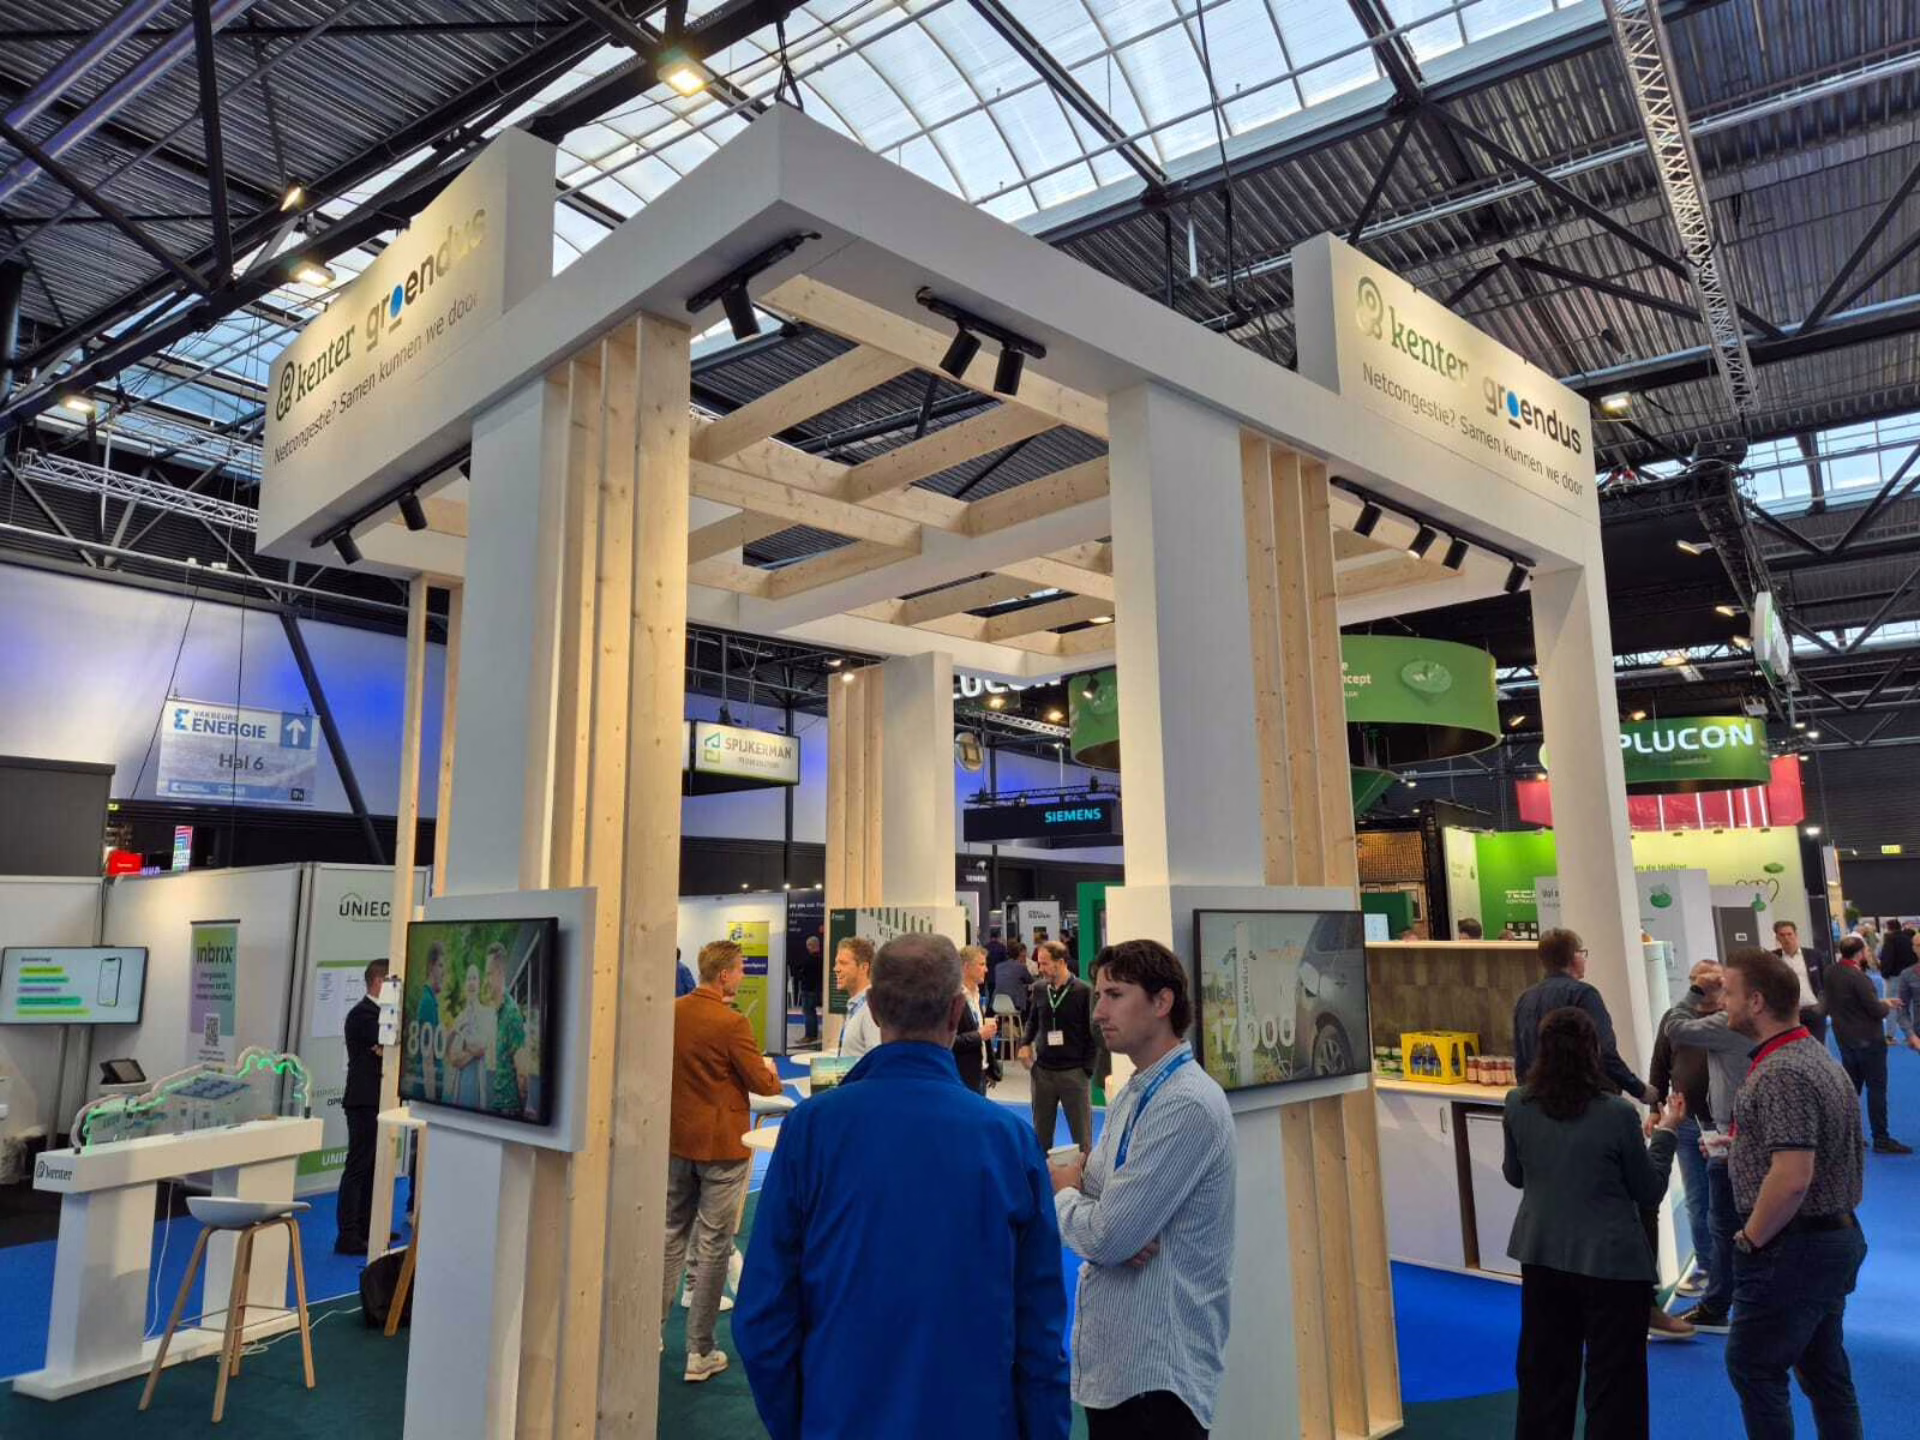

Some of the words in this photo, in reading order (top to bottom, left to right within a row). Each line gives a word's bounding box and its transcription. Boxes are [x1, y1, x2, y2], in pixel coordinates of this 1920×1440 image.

[365, 207, 486, 353] groendus
[296, 324, 355, 402] kenter
[1390, 306, 1469, 381] kenter
[273, 400, 337, 465] Netcongestie?
[339, 374, 376, 415] Samen
[379, 336, 421, 383] kunnen
[425, 315, 446, 345] we
[448, 291, 478, 328] door
[1362, 362, 1455, 429] Netcongestie?
[1460, 415, 1501, 454] Samen
[1504, 442, 1543, 475] kunnen
[1546, 467, 1560, 486] we
[1562, 471, 1583, 497] door
[1482, 374, 1582, 455] groendus
[192, 718, 267, 739] ENERGIE
[219, 753, 249, 771] Hal
[252, 757, 265, 771] 6
[1044, 808, 1102, 823] SIEMENS
[339, 901, 391, 917] UNIEC
[407, 1021, 446, 1059] 800
[44, 1164, 73, 1181] kenter
